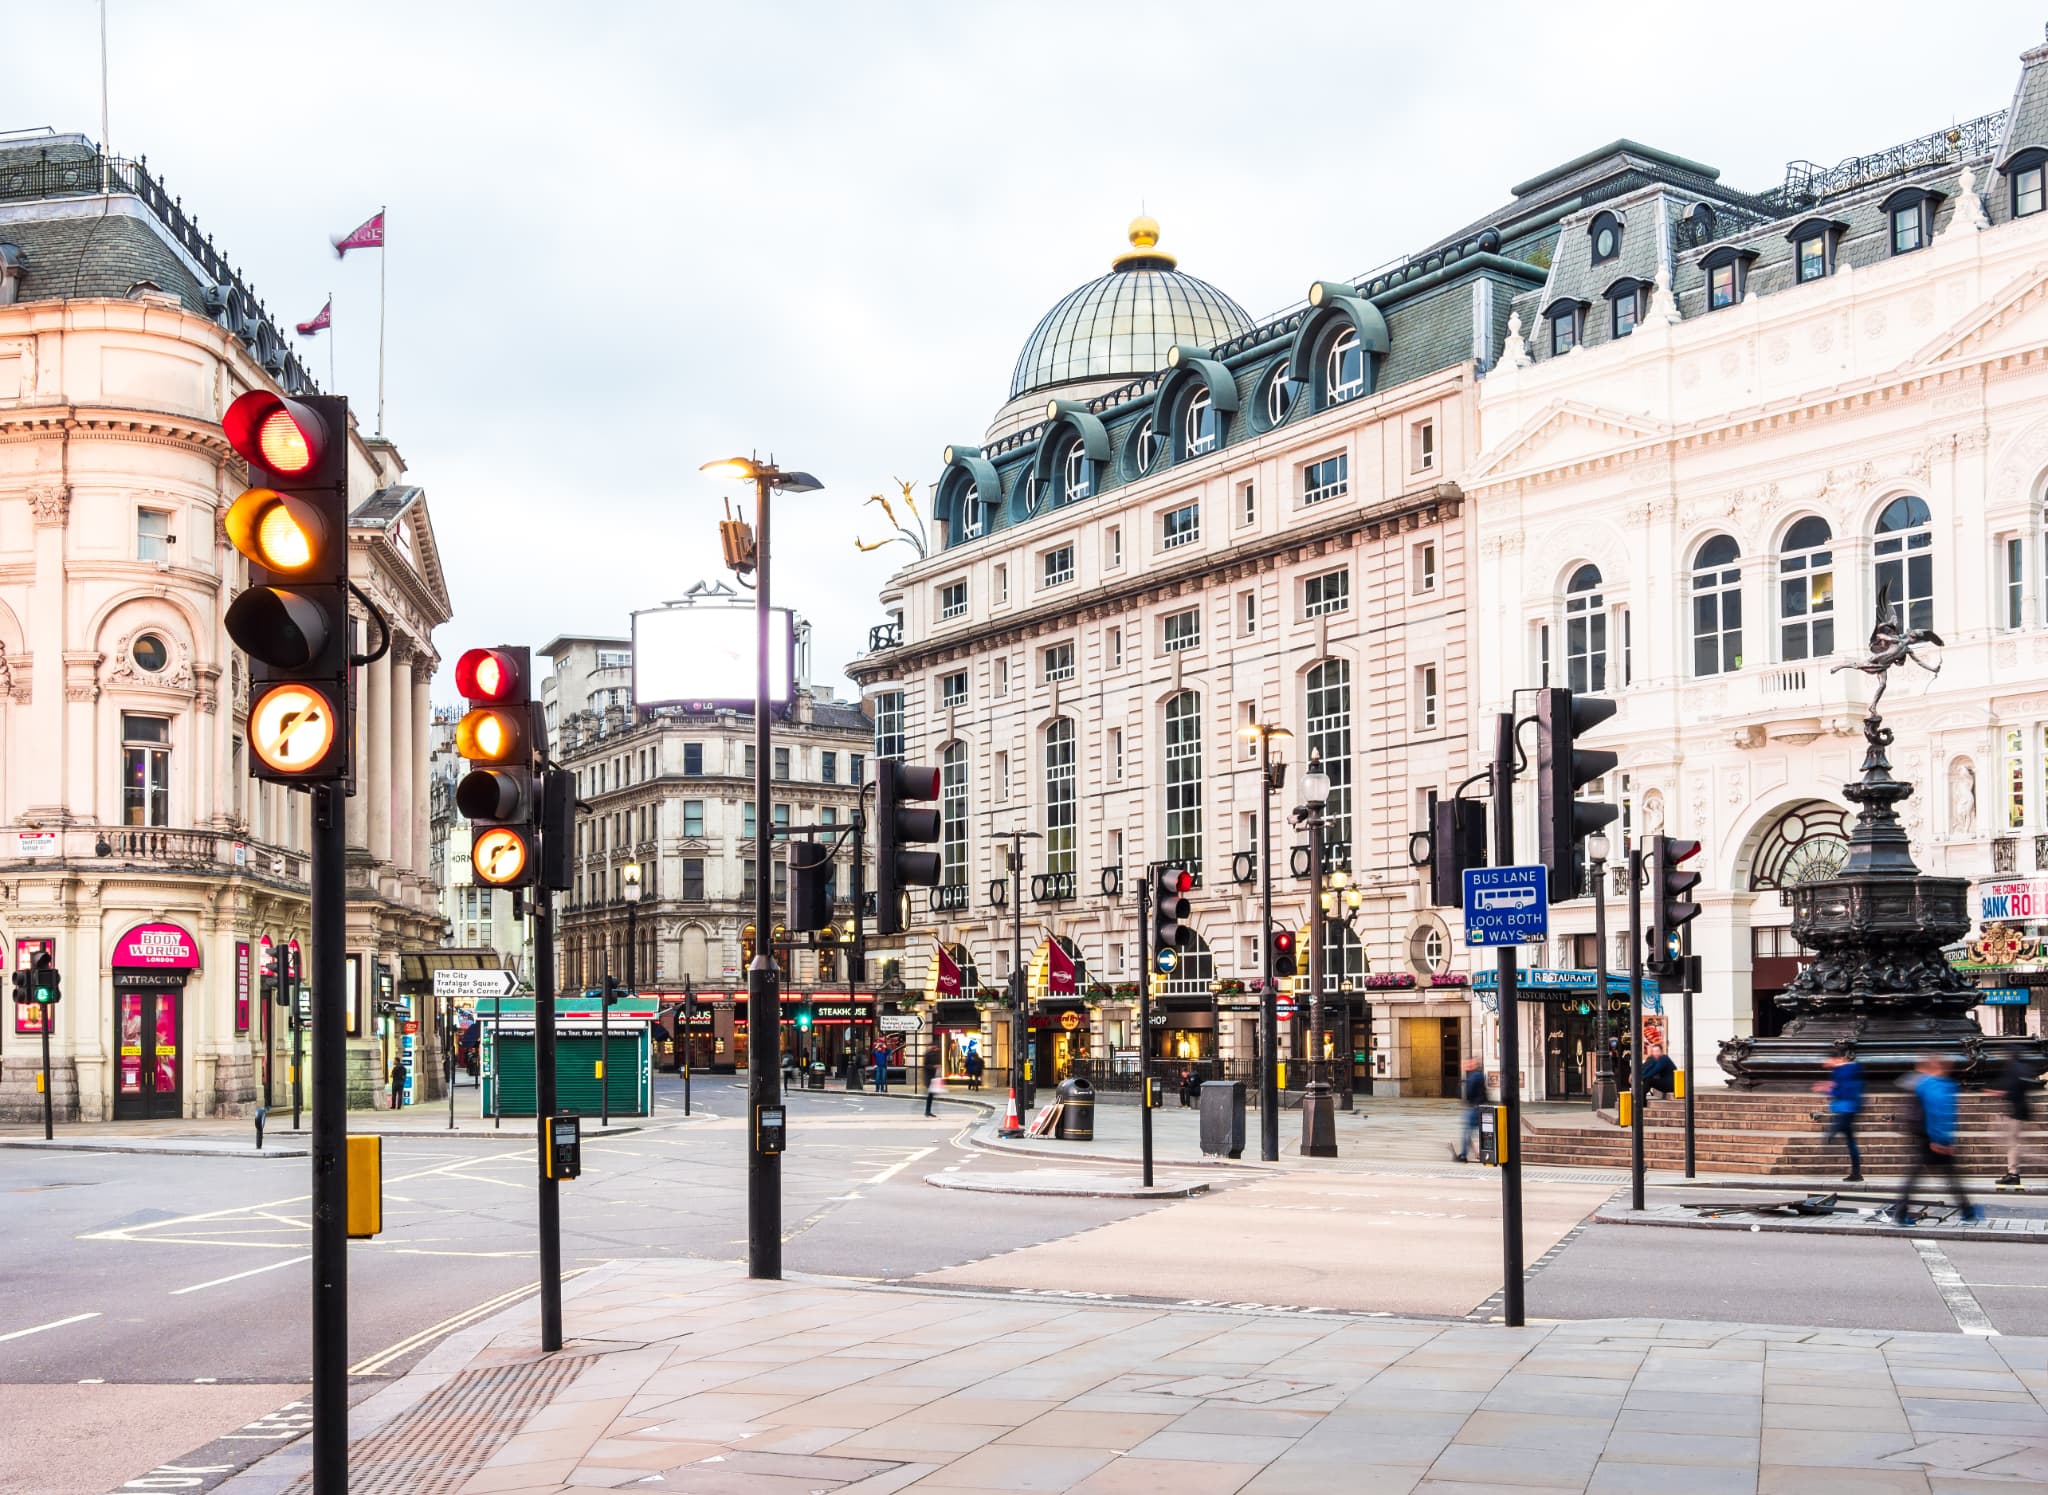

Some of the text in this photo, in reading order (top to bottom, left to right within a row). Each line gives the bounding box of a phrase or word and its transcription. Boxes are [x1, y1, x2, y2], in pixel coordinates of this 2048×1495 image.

[703, 702, 713, 710] LG
[1473, 871, 1537, 885] BUS LANE
[1992, 885, 2002, 895] THE
[2003, 883, 2029, 894] COMEDY
[1982, 895, 2009, 919] BANK
[1470, 913, 1542, 927] LOOK BOTH
[143, 934, 181, 945] BODY
[1489, 930, 1524, 942] WAYS
[131, 945, 188, 956] WORLDS
[120, 975, 183, 984] ATTRACTION
[1534, 972, 1592, 983] RESTAURANT
[1562, 999, 1621, 1011] GRANIO
[679, 1011, 712, 1019] AUS
